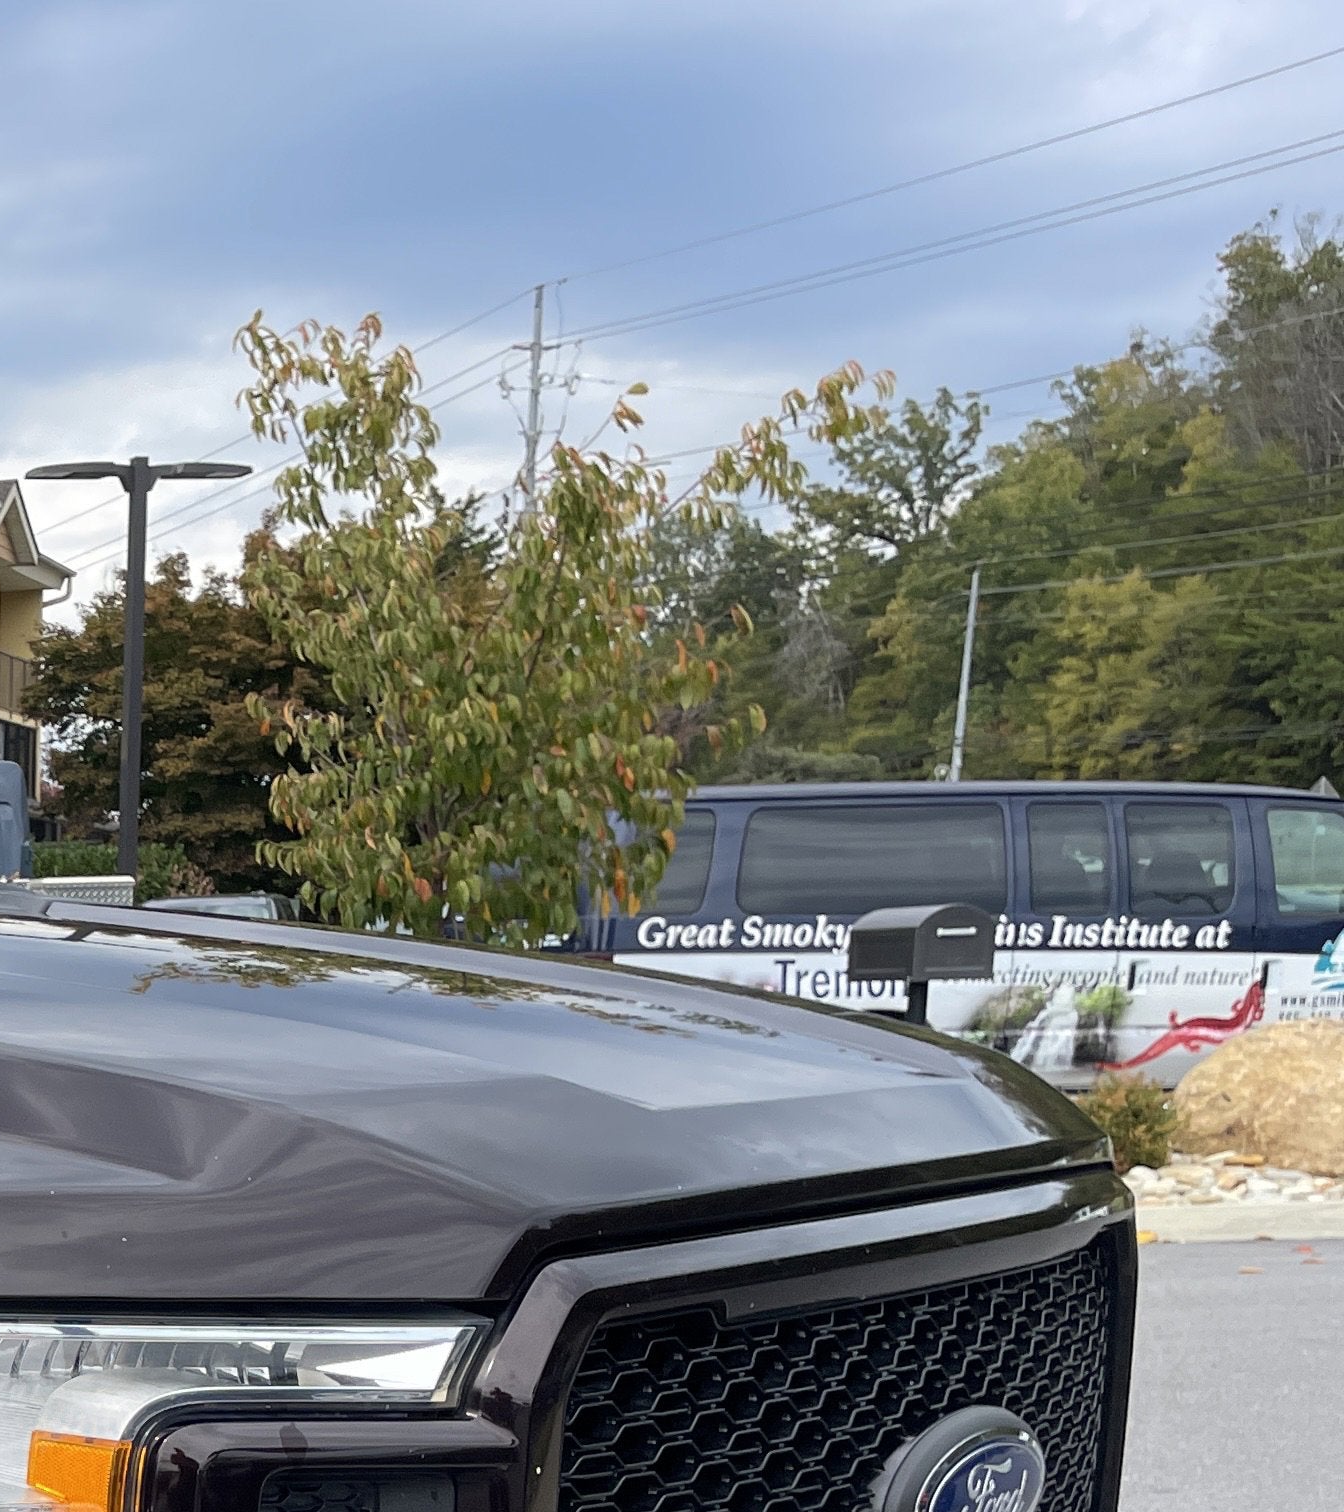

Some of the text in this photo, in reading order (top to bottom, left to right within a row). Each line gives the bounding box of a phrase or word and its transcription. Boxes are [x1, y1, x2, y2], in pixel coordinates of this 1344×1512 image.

[636, 916, 736, 950] Great
[740, 914, 854, 955] Smoky
[1047, 914, 1190, 949] Institute
[1195, 918, 1232, 949] at
[774, 958, 910, 999] Tremon
[1138, 964, 1180, 986] and
